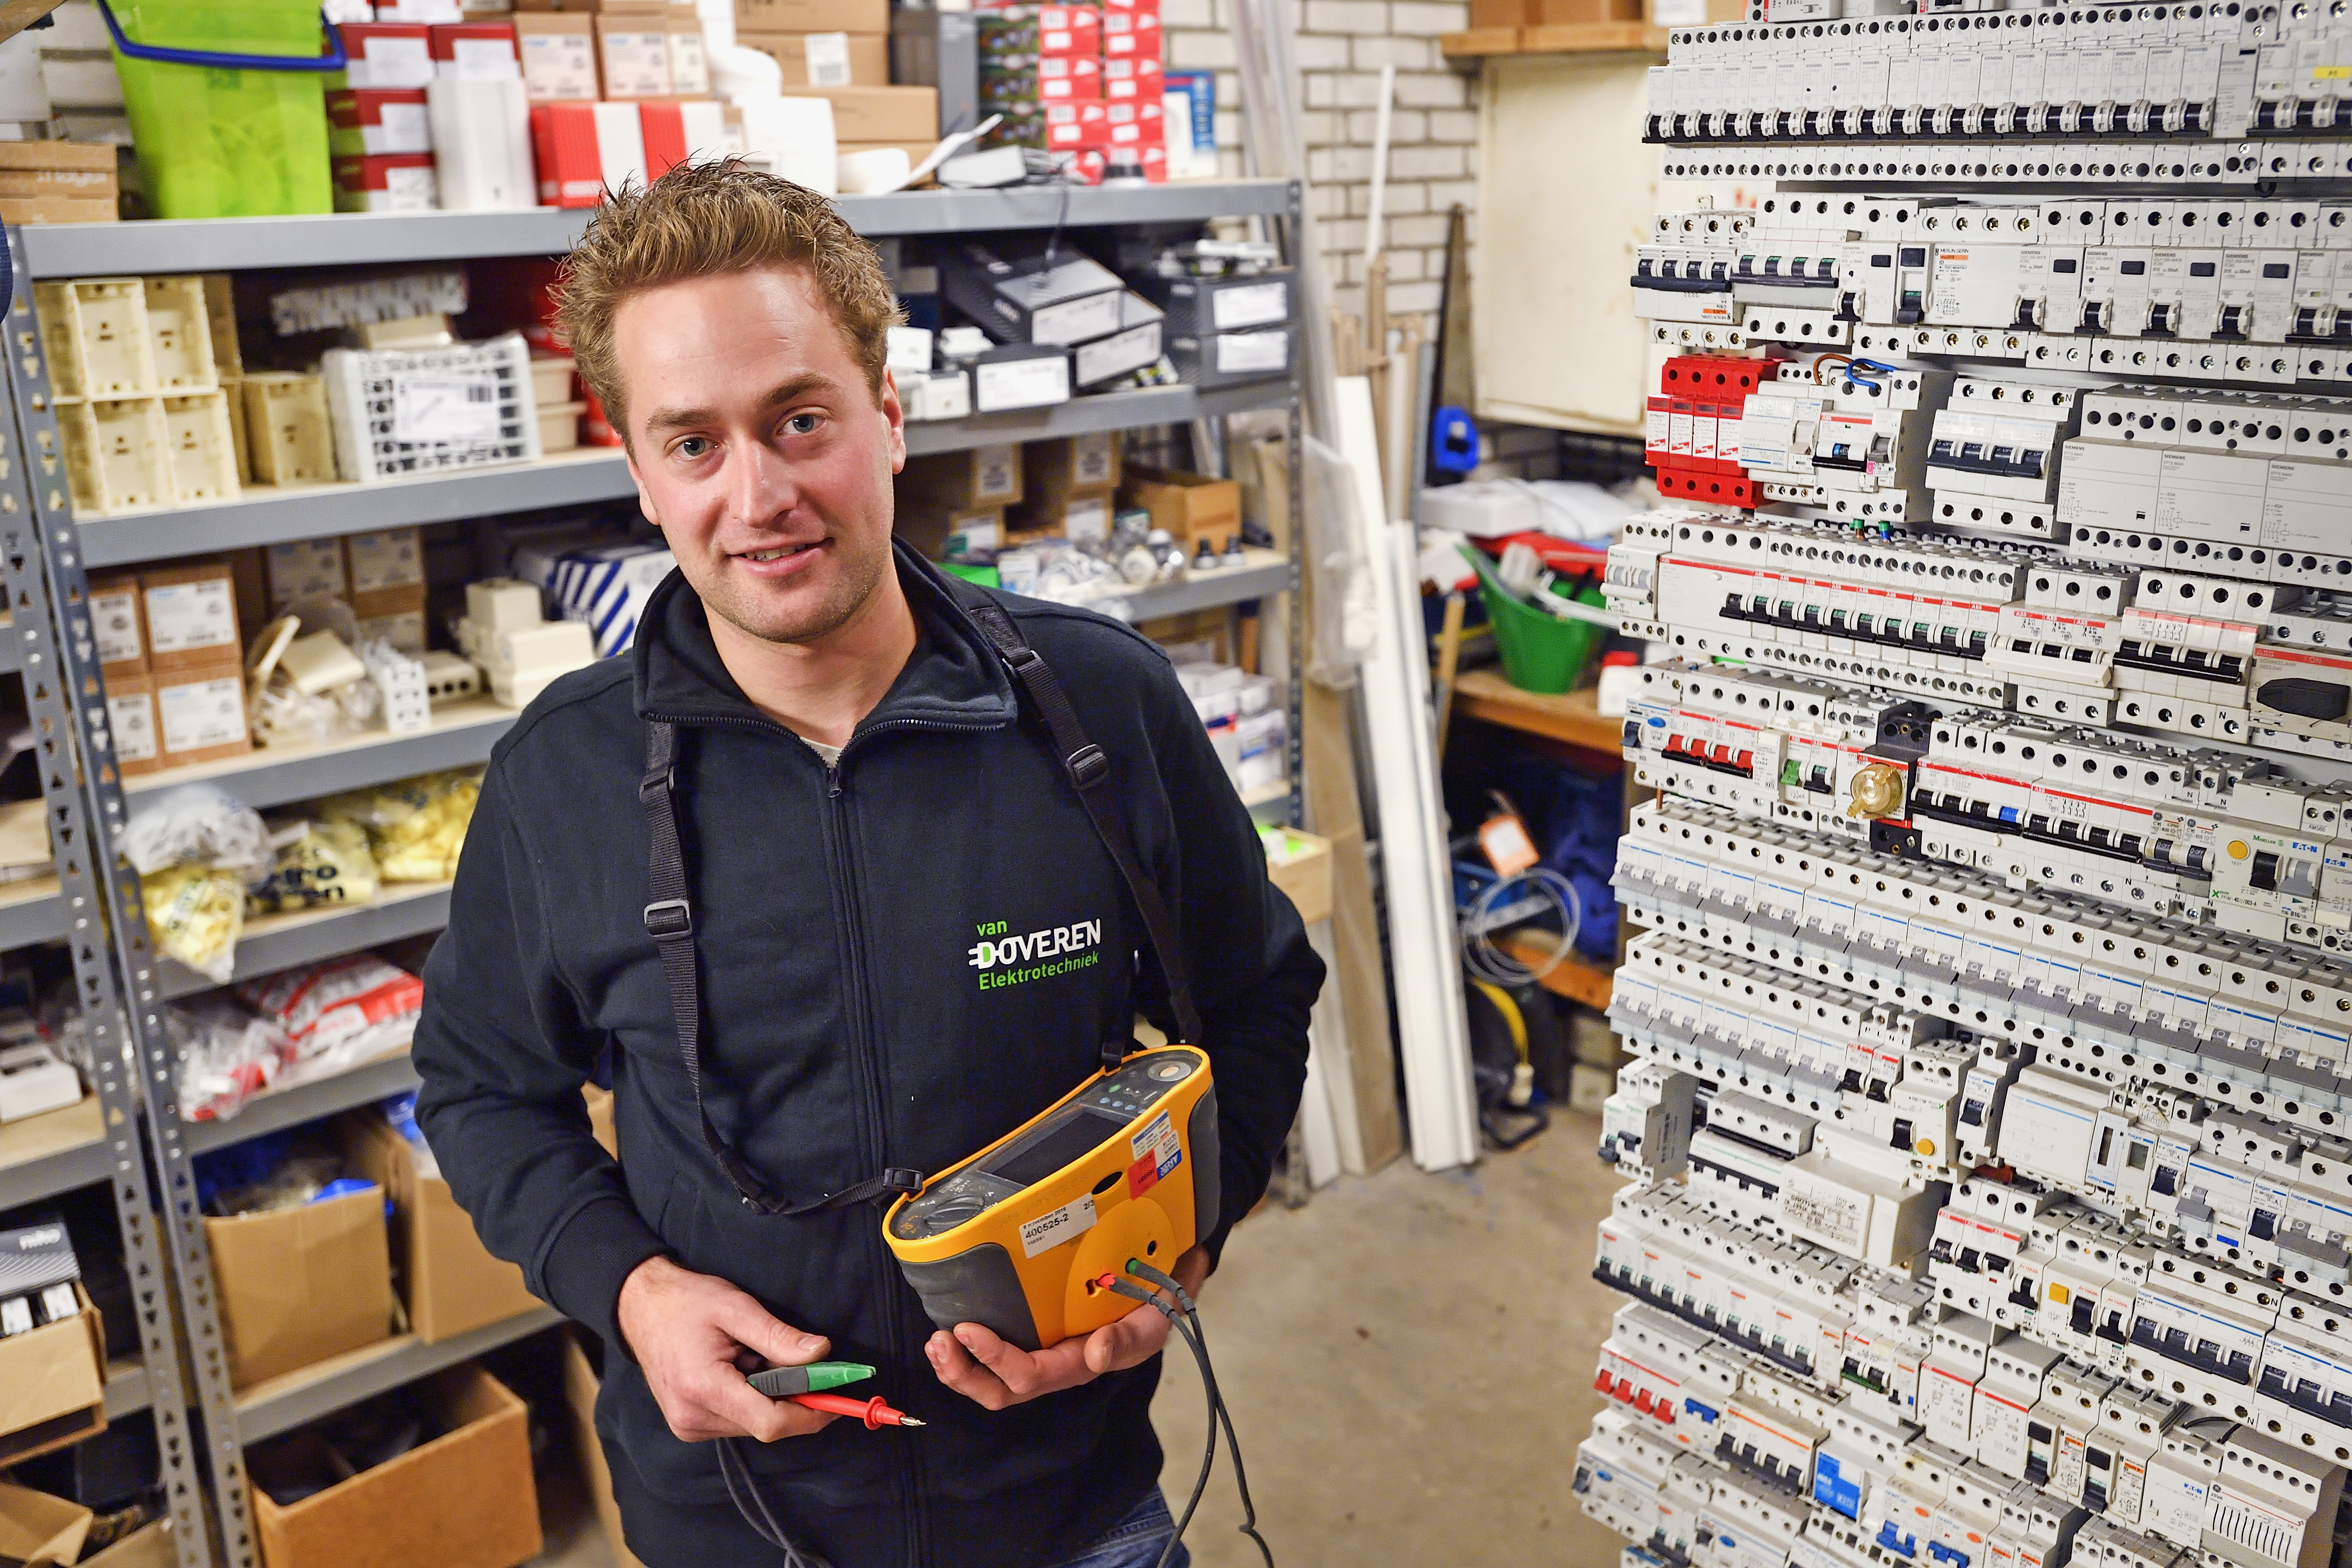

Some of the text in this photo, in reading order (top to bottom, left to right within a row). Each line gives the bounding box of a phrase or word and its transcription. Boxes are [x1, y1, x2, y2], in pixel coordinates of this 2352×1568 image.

[2066, 394, 2072, 402] N
[2219, 711, 2226, 719] N
[976, 920, 1008, 937] van
[968, 918, 1102, 970] DOVEREN
[1965, 937, 1978, 945] hager
[2022, 953, 2035, 961] hager
[978, 950, 1100, 991] Elektrotechniek
[2082, 968, 2096, 976] hager
[2145, 985, 2159, 993] hager
[2210, 1002, 2226, 1010] hager
[2279, 1020, 2295, 1029] hager
[2128, 1132, 2142, 1141] hager
[2159, 1139, 2174, 1147] hager
[2255, 1183, 2270, 1191] hager
[2291, 1193, 2307, 1202] hager
[1083, 1199, 1094, 1210] 2/3
[1025, 1213, 1070, 1239] 400525-2
[2137, 1290, 2152, 1298] hager
[2266, 1338, 2281, 1347] hager
